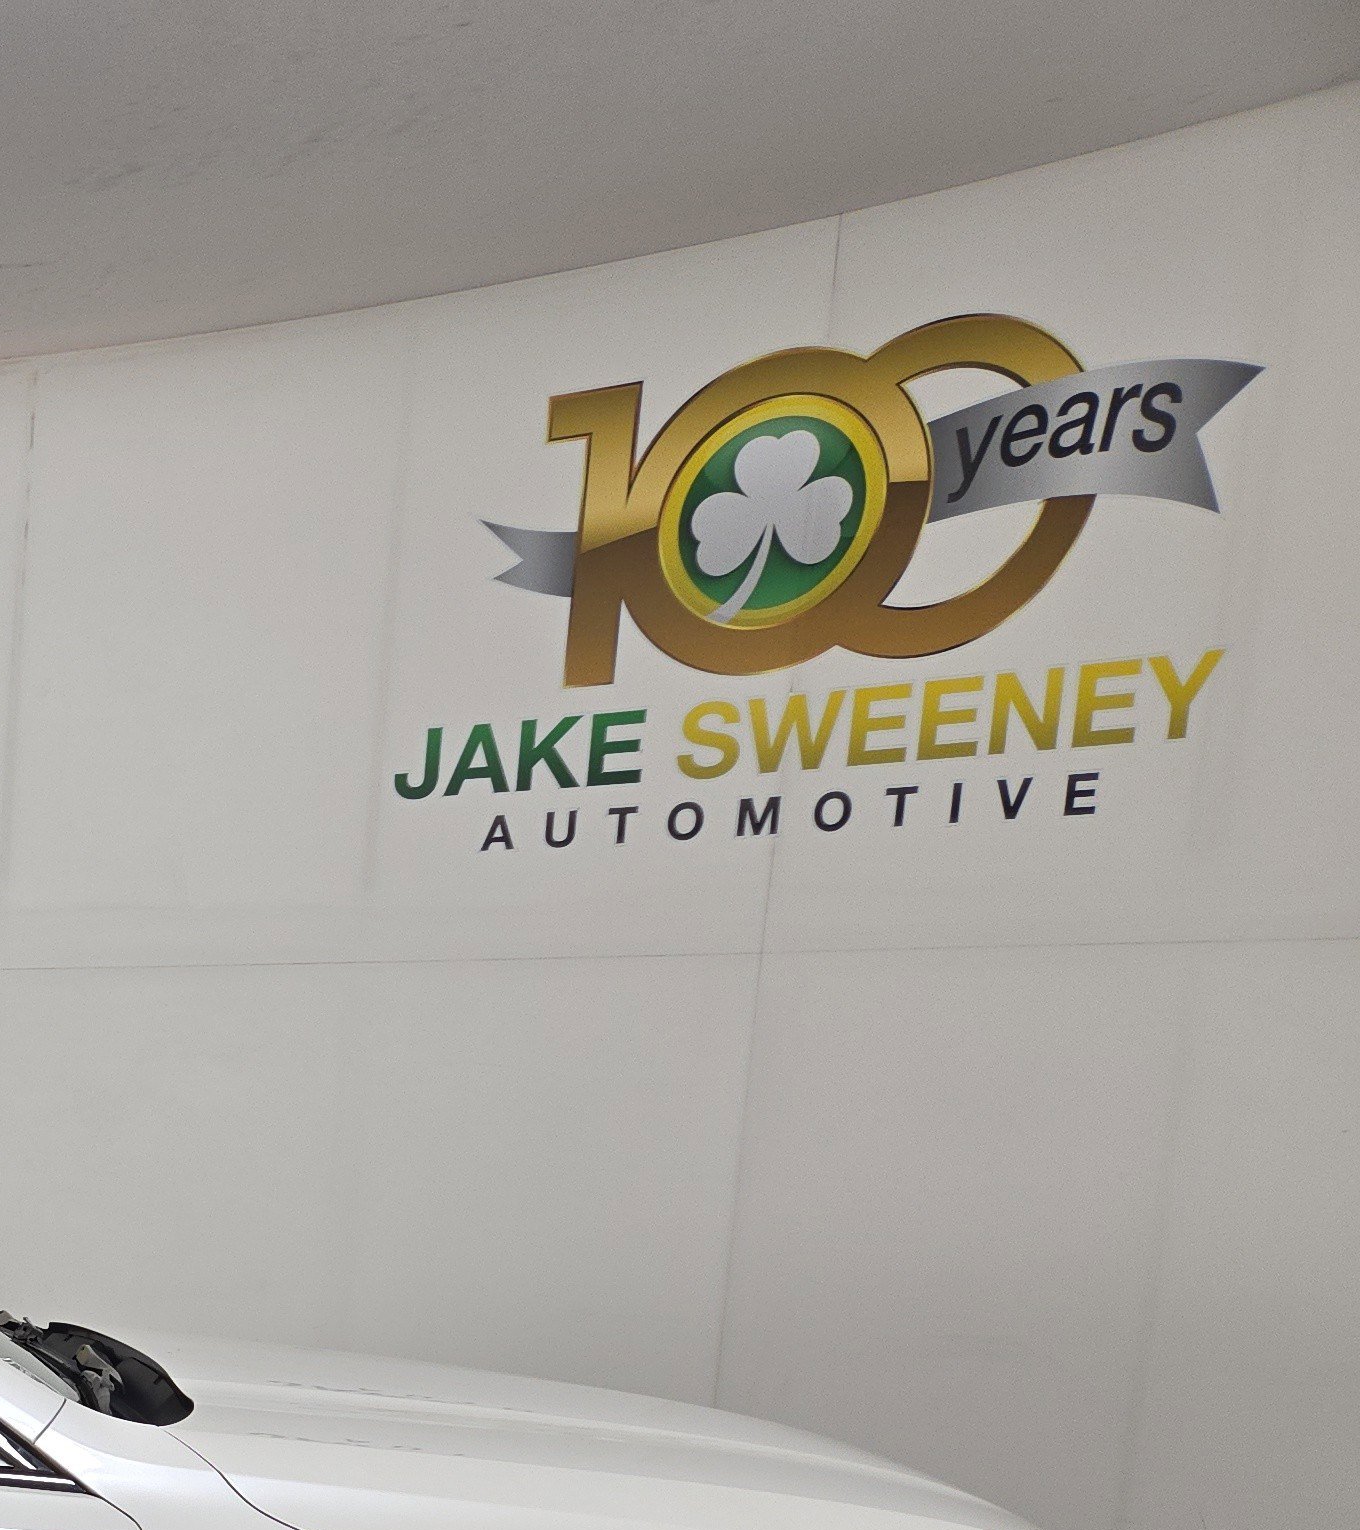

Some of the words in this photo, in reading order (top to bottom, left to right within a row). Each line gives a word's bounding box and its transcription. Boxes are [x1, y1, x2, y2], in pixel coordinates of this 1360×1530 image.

[546, 313, 1098, 688] 100
[946, 377, 1183, 504] years
[394, 708, 648, 800] JAKE
[676, 649, 1226, 780] SWEENEY
[481, 771, 1099, 852] AUTOMOTIVE
